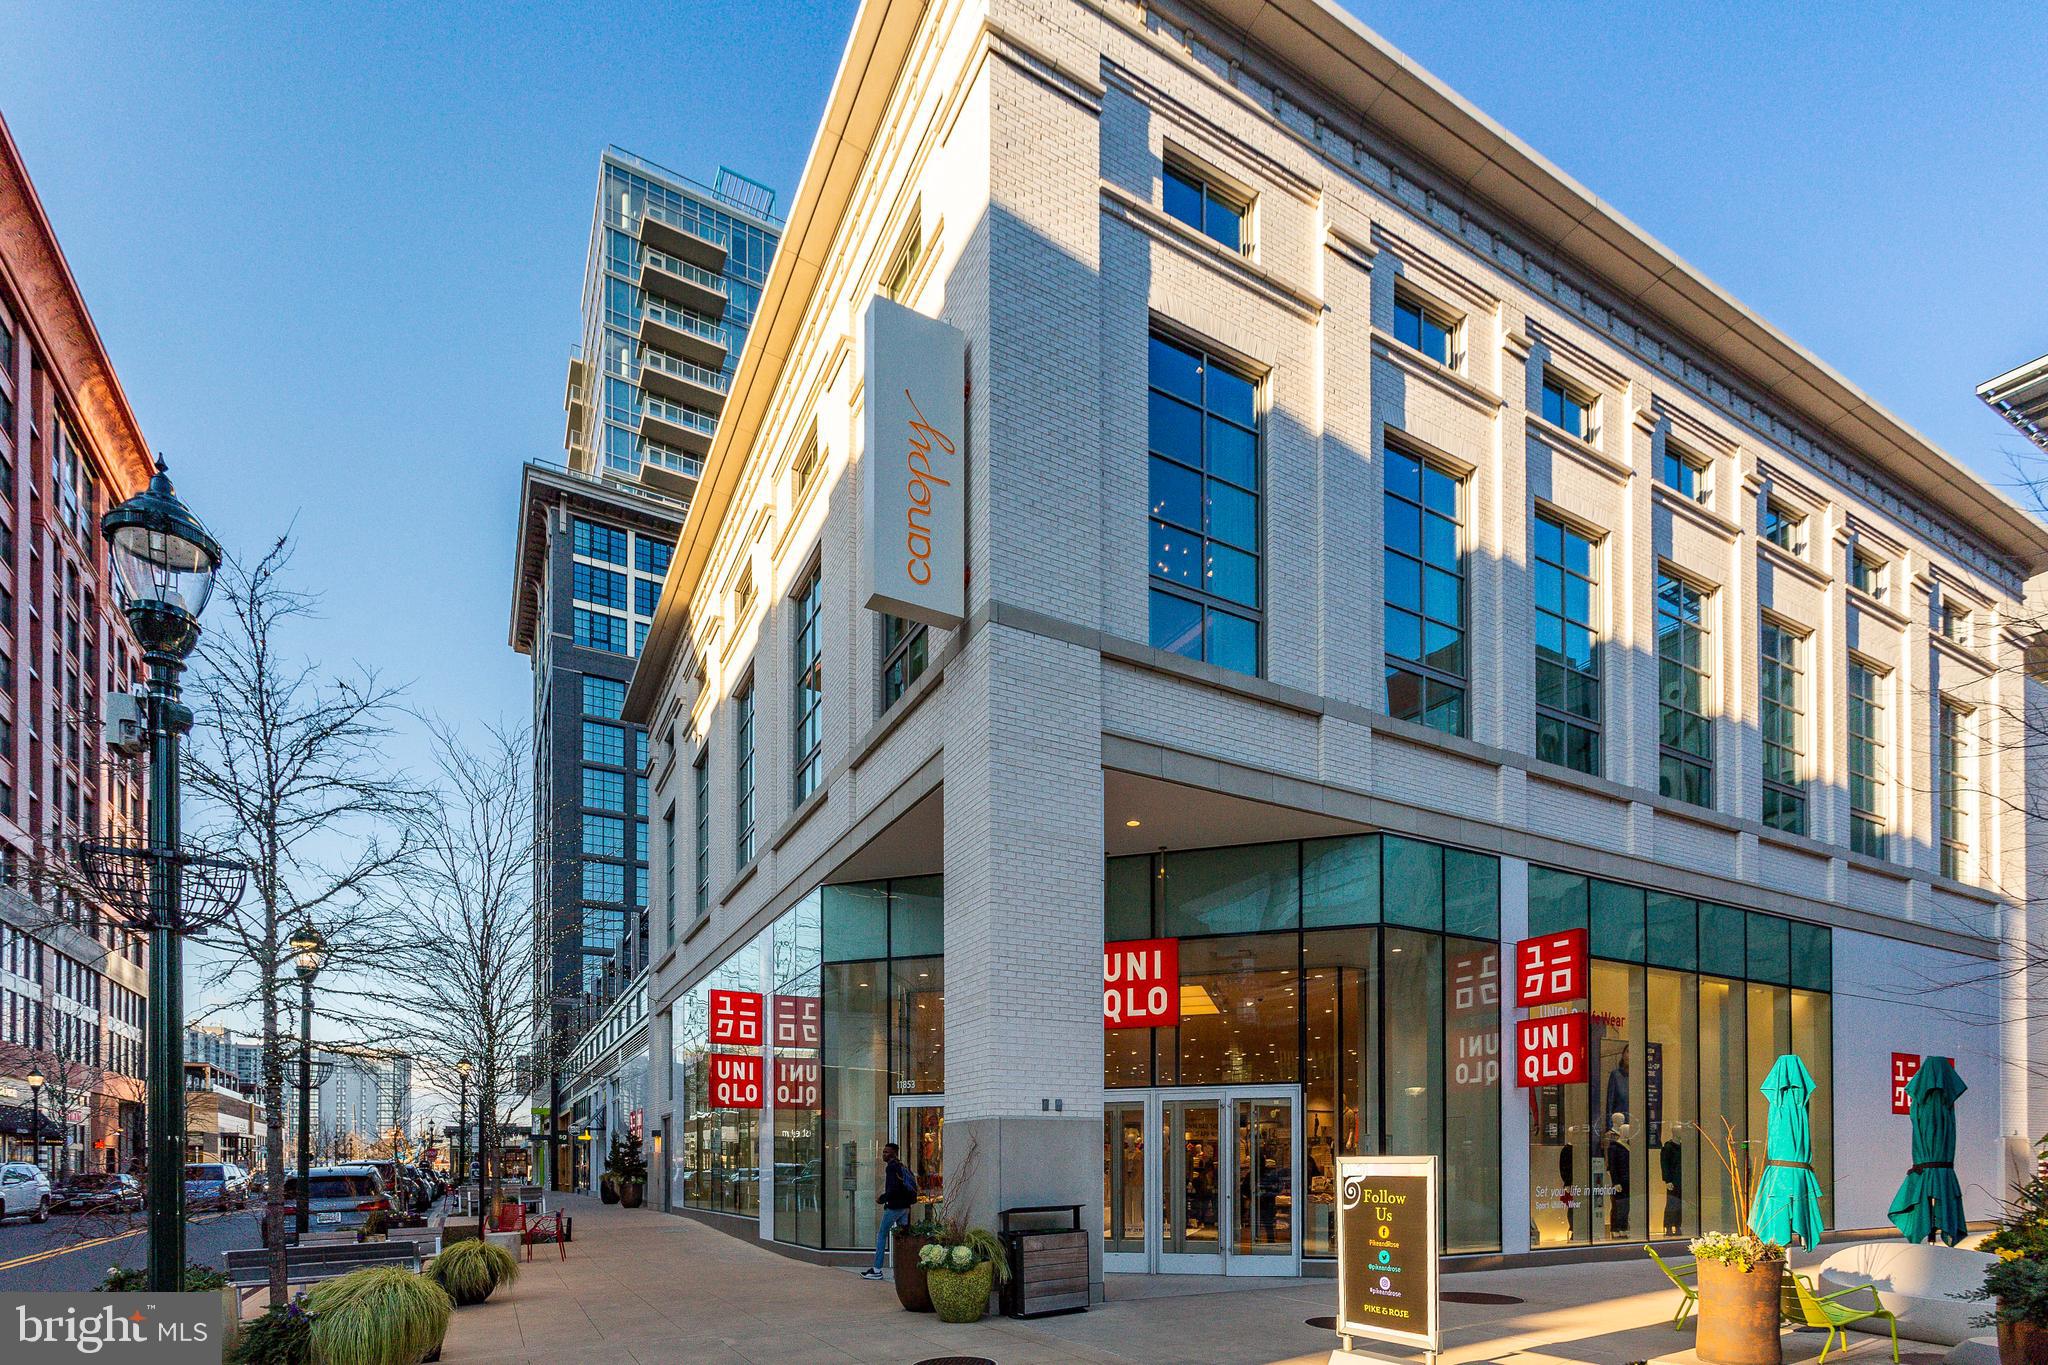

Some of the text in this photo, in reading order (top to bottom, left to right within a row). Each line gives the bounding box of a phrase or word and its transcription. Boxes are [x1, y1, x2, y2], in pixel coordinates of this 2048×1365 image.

[905, 389, 955, 585] canopy
[1104, 950, 1162, 982] UNI
[1104, 986, 1168, 1023] QLO
[1524, 1023, 1569, 1051] UNI
[717, 1060, 754, 1080] UNI
[1524, 1052, 1573, 1082] QLO
[717, 1083, 758, 1105] QLO
[896, 1080, 916, 1089] 11853
[1363, 1189, 1406, 1205] Follow
[1535, 1185, 1548, 1198] Set
[1551, 1187, 1567, 1199] your
[1584, 1185, 1591, 1196] in
[1592, 1184, 1617, 1196] motion
[1375, 1207, 1393, 1222] Us
[1364, 1304, 1410, 1318] PIKE & ROSE
